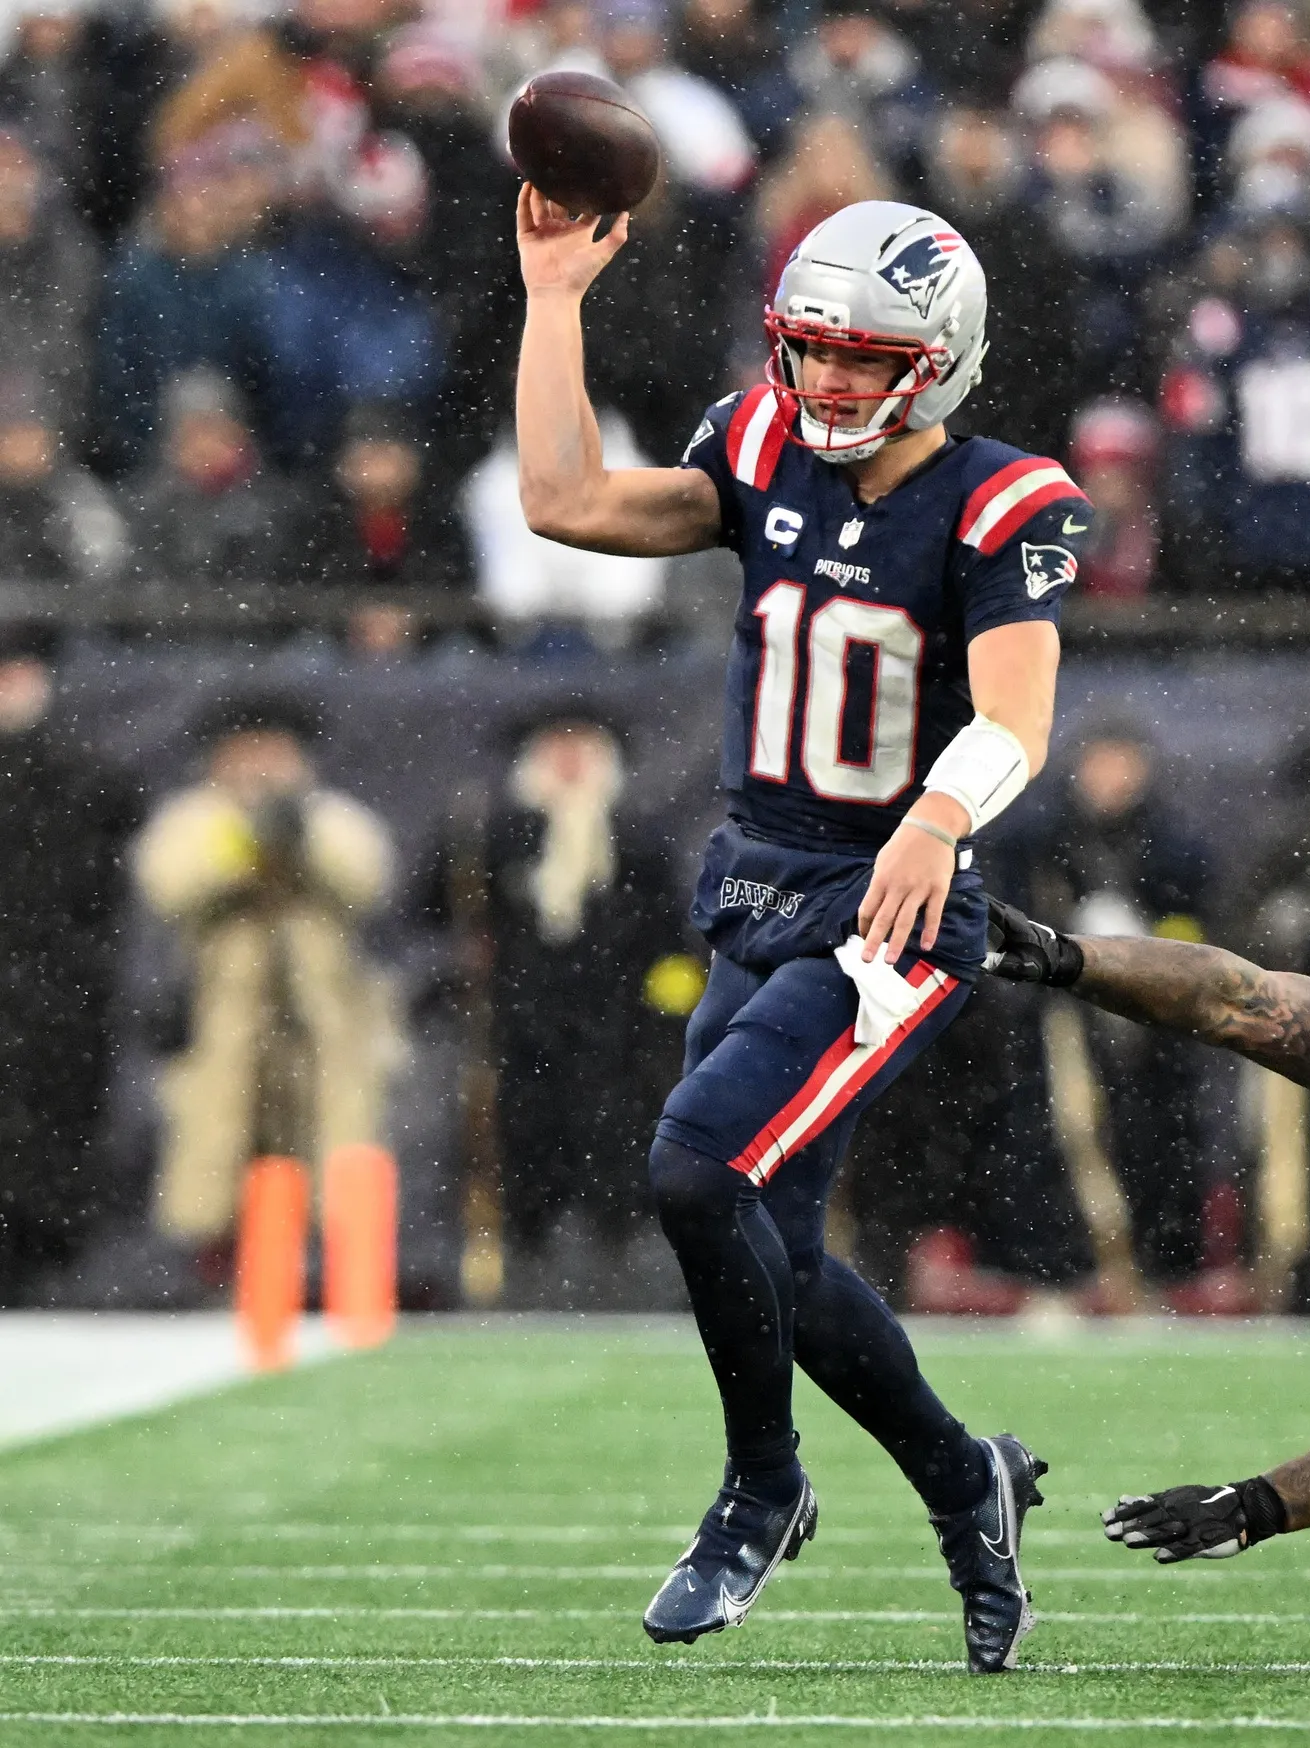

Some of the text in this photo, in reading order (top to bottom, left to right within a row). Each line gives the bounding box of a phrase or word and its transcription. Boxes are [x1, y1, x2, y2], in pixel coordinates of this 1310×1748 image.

[764, 506, 803, 545] C
[813, 558, 872, 584] PATRIOTS
[750, 578, 924, 806] 10
[720, 876, 806, 919] PATROTS
